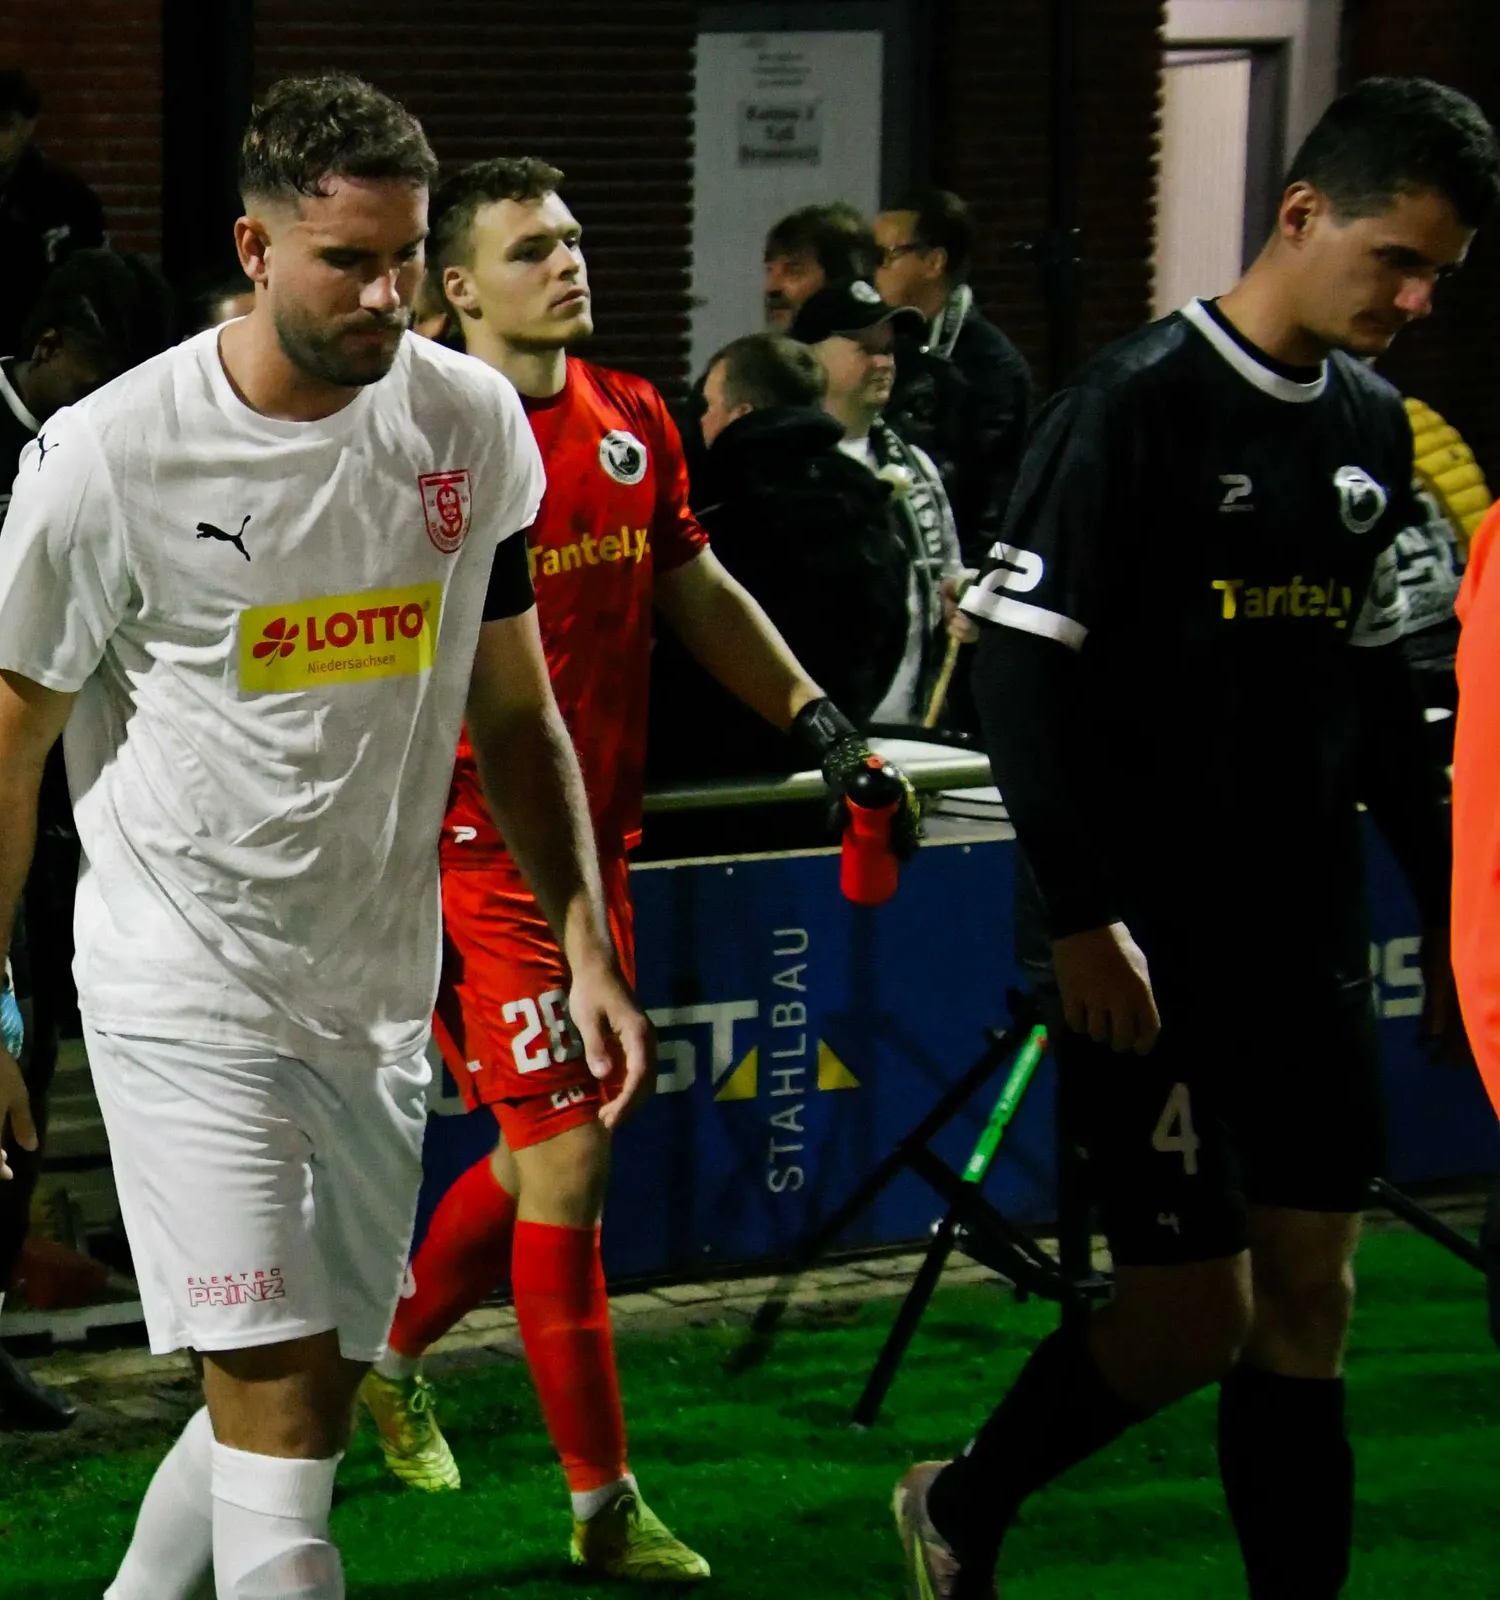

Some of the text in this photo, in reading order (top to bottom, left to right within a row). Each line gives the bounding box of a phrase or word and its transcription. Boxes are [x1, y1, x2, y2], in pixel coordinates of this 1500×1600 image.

[306, 603, 424, 651] LOTTO
[308, 654, 396, 674] Niedersachsen
[767, 928, 809, 1193] STAHLBAU
[1152, 1082, 1200, 1175] 4
[187, 1268, 280, 1285] ELEKTRO
[189, 1278, 286, 1307] PRINZ
